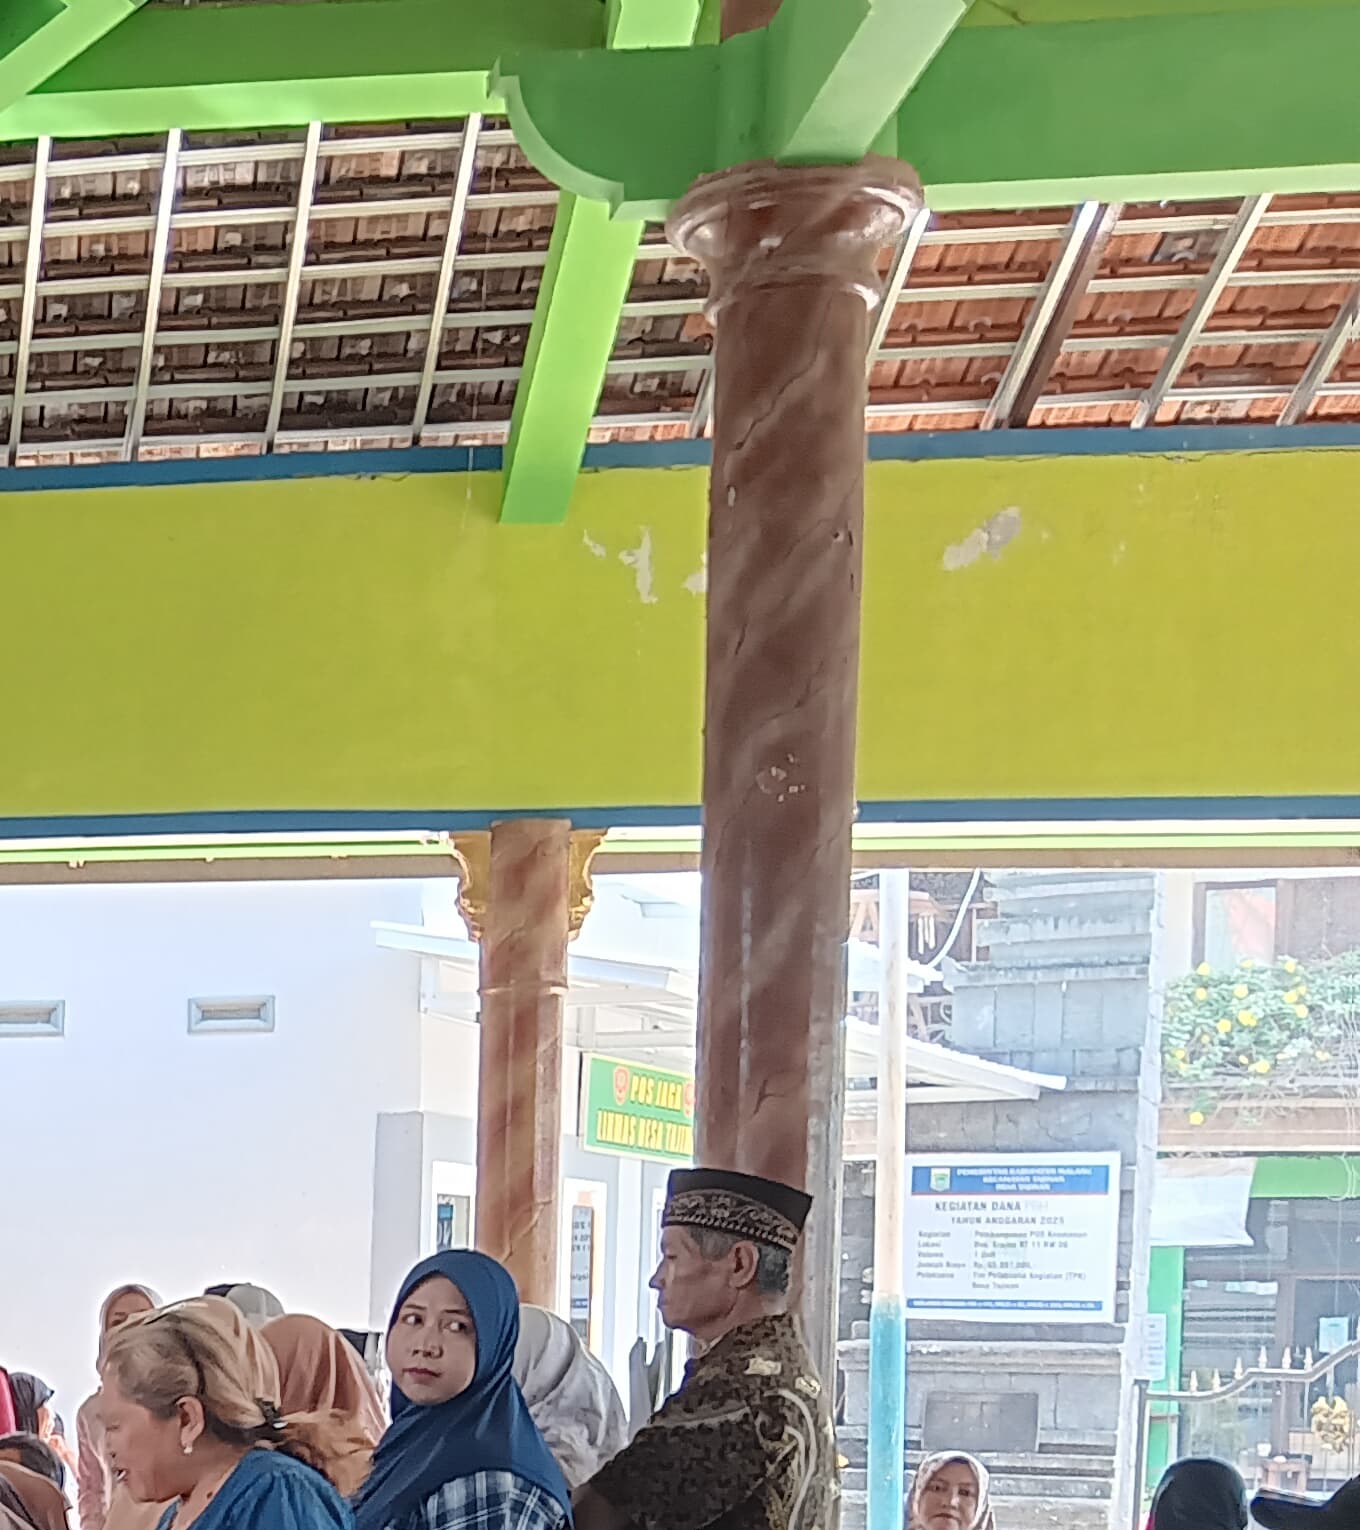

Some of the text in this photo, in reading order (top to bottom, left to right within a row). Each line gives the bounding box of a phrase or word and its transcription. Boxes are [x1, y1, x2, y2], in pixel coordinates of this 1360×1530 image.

[630, 1074, 655, 1105] POS
[935, 1201, 987, 1211] KEGIATAN
[991, 1201, 1021, 1211] DANA
[951, 1216, 982, 1225] TAHUN
[985, 1216, 1037, 1225] ANGGARAN
